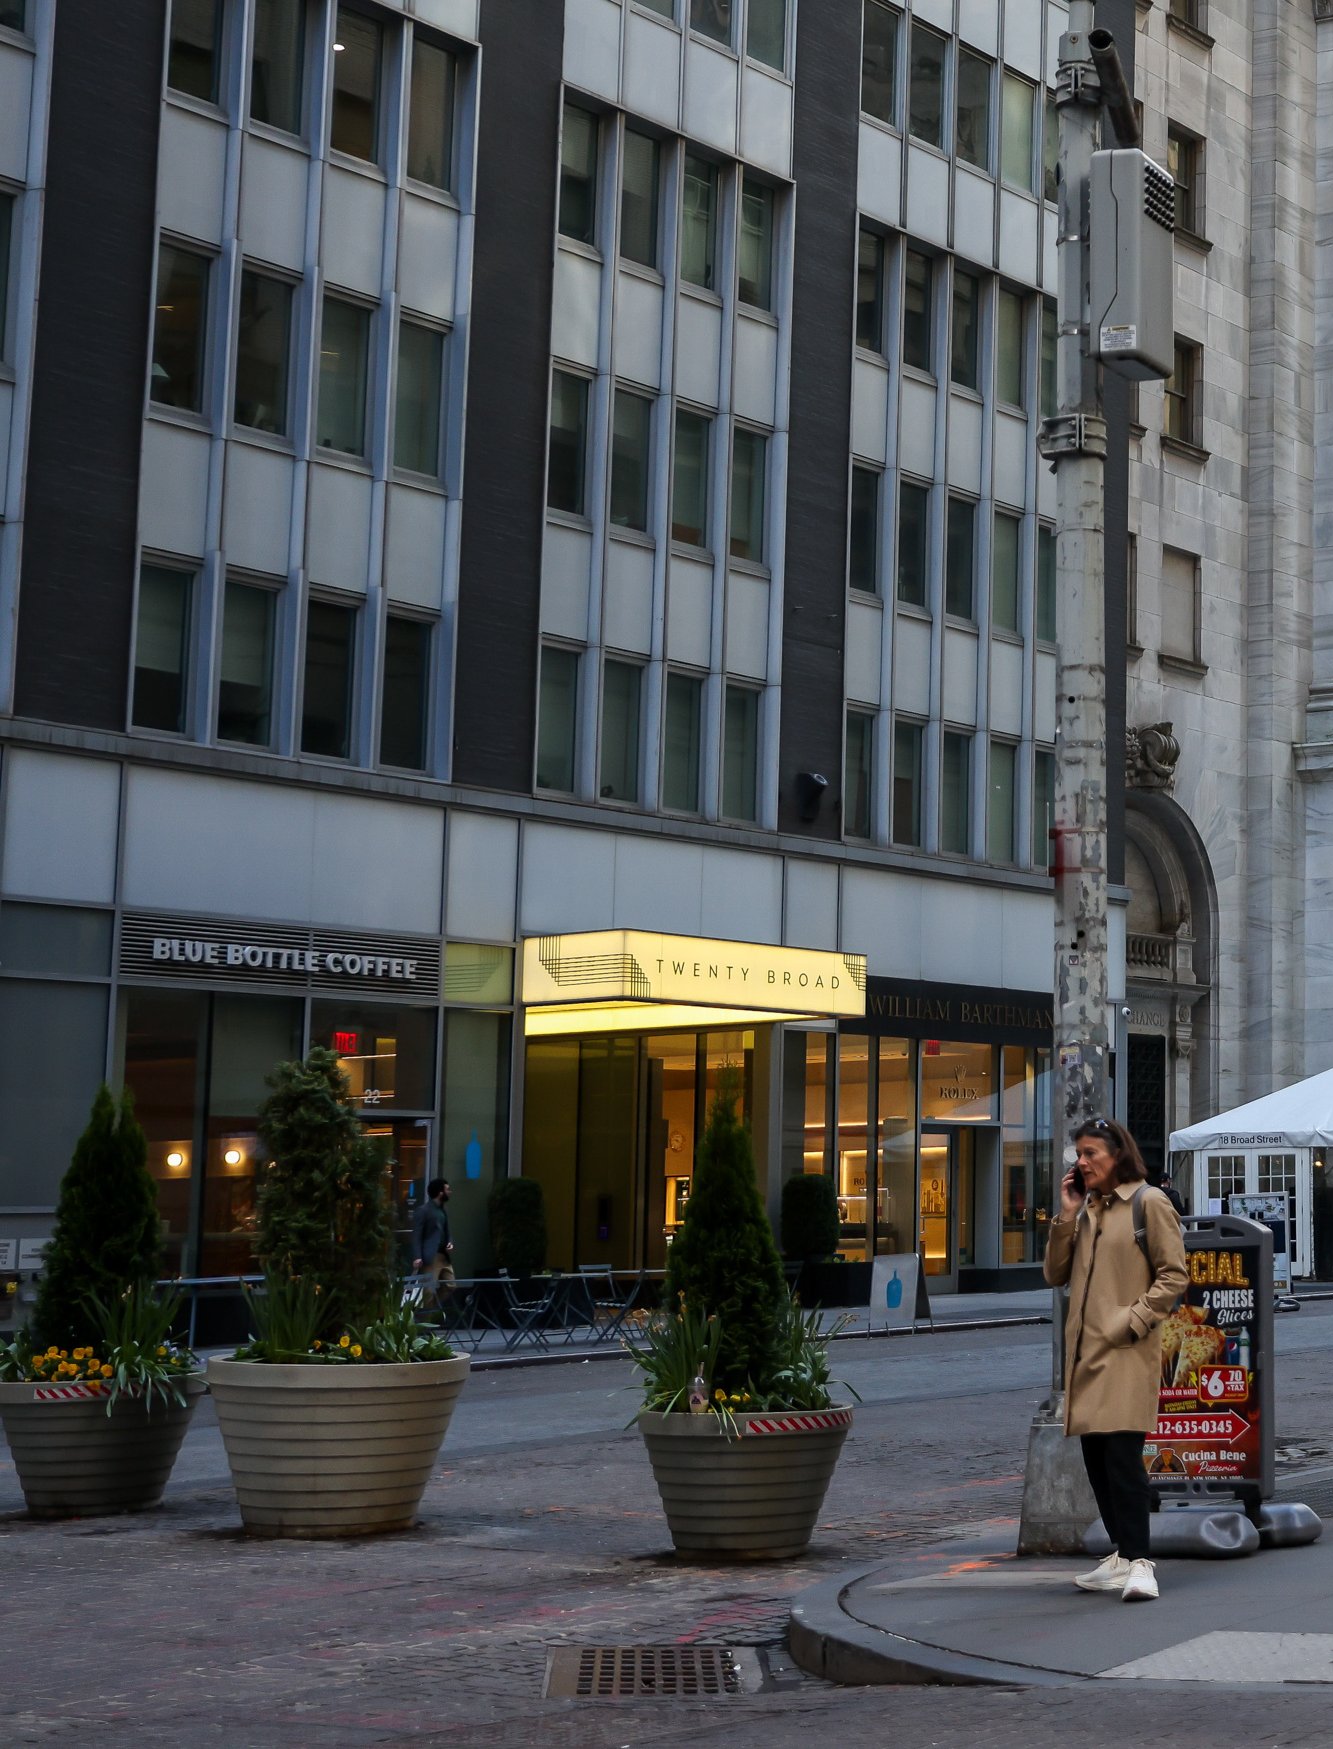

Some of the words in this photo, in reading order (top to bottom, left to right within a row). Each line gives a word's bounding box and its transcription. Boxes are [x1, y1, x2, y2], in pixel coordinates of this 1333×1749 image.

[153, 938, 220, 964] BLUE
[226, 944, 320, 972] BOTTLE
[325, 953, 418, 979] COFFEE
[656, 959, 750, 981] TWENTY
[767, 970, 840, 989] BROAD
[868, 994, 951, 1022] WILLIAM
[960, 1000, 1054, 1029] BARTHMAN
[364, 1089, 381, 1104] 22
[939, 1087, 980, 1100] ROLEX
[1220, 1136, 1229, 1144] 18
[1231, 1135, 1255, 1144] Broad
[1257, 1135, 1282, 1144] Street
[1203, 1291, 1211, 1308] 2
[1213, 1289, 1254, 1309] CHEESE
[1217, 1309, 1253, 1325] Slices
[1229, 1370, 1243, 1382] 70
[1151, 1420, 1232, 1434] 12-635-0345
[1182, 1450, 1217, 1462] Cucina
[1220, 1450, 1246, 1461] Bene
[1198, 1461, 1238, 1474] Pizzeria
